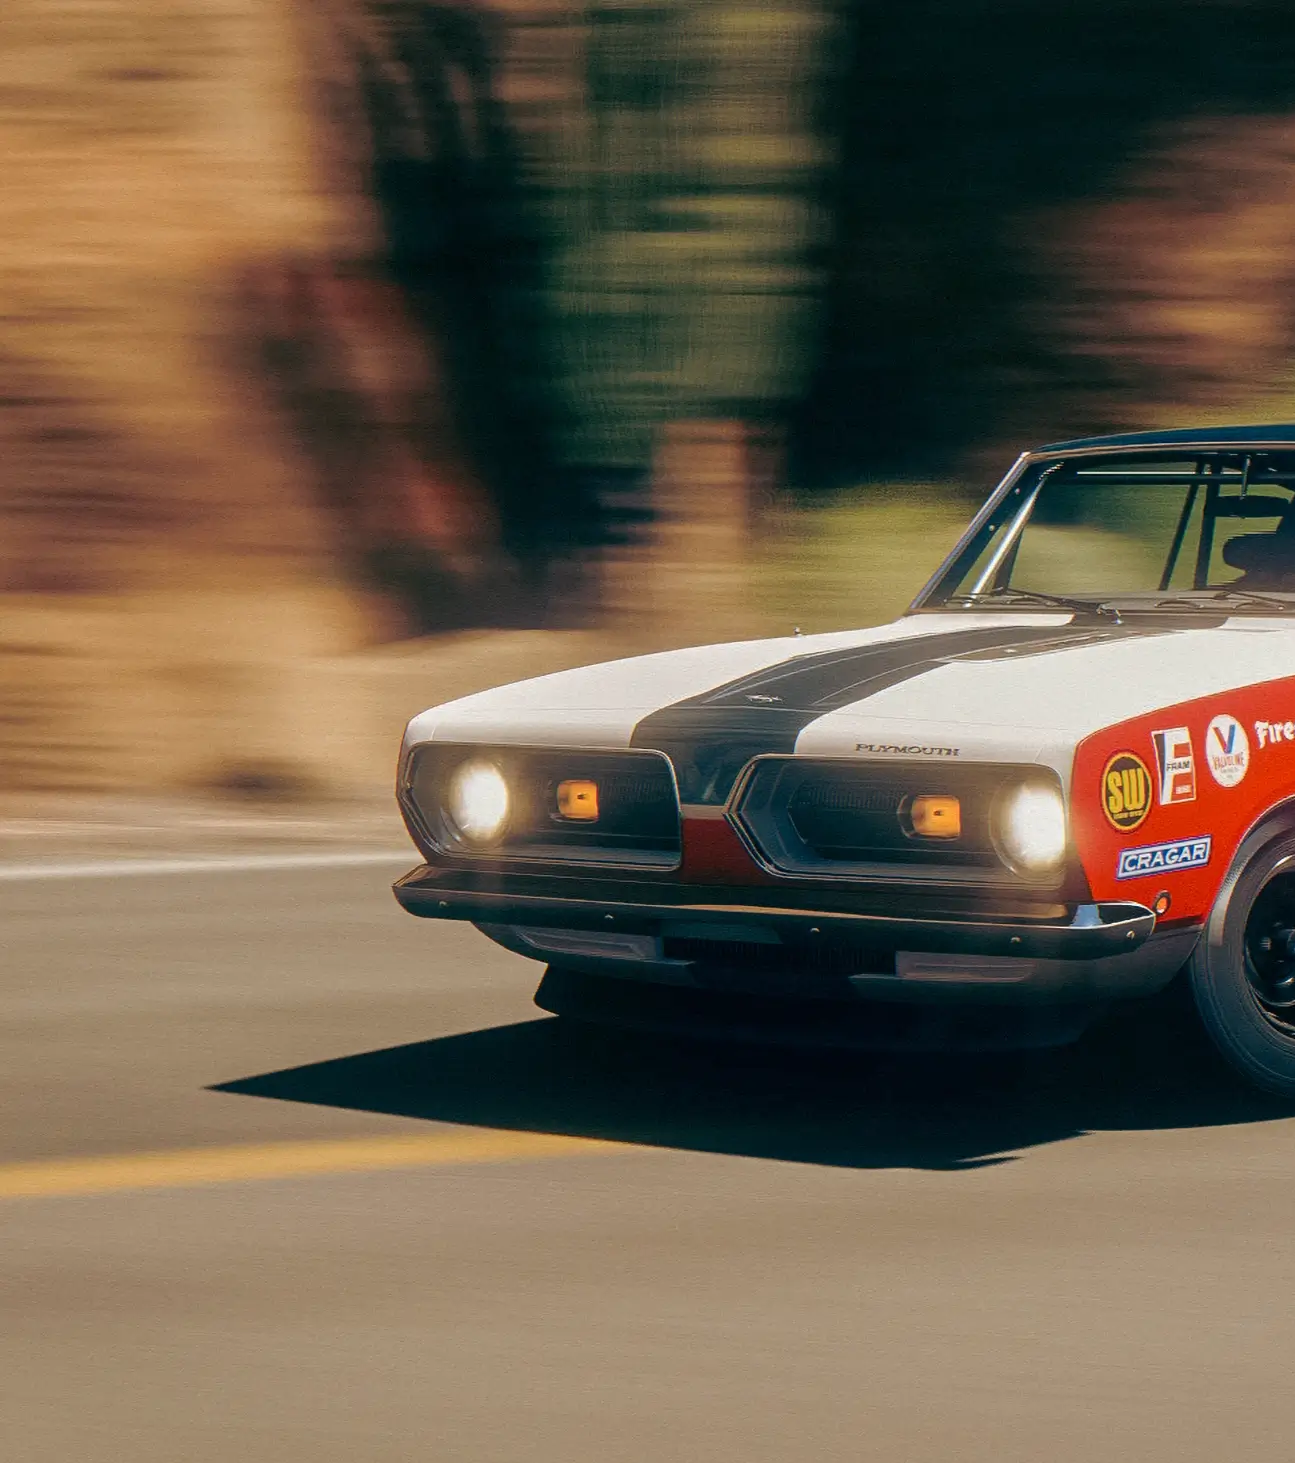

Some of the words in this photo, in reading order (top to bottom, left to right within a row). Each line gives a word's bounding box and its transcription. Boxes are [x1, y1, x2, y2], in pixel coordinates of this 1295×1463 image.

[854, 743, 960, 757] PLYMOUTH
[1165, 760, 1190, 772] FRAM
[1107, 767, 1145, 814] SW
[1124, 843, 1207, 871] CRAGAR
